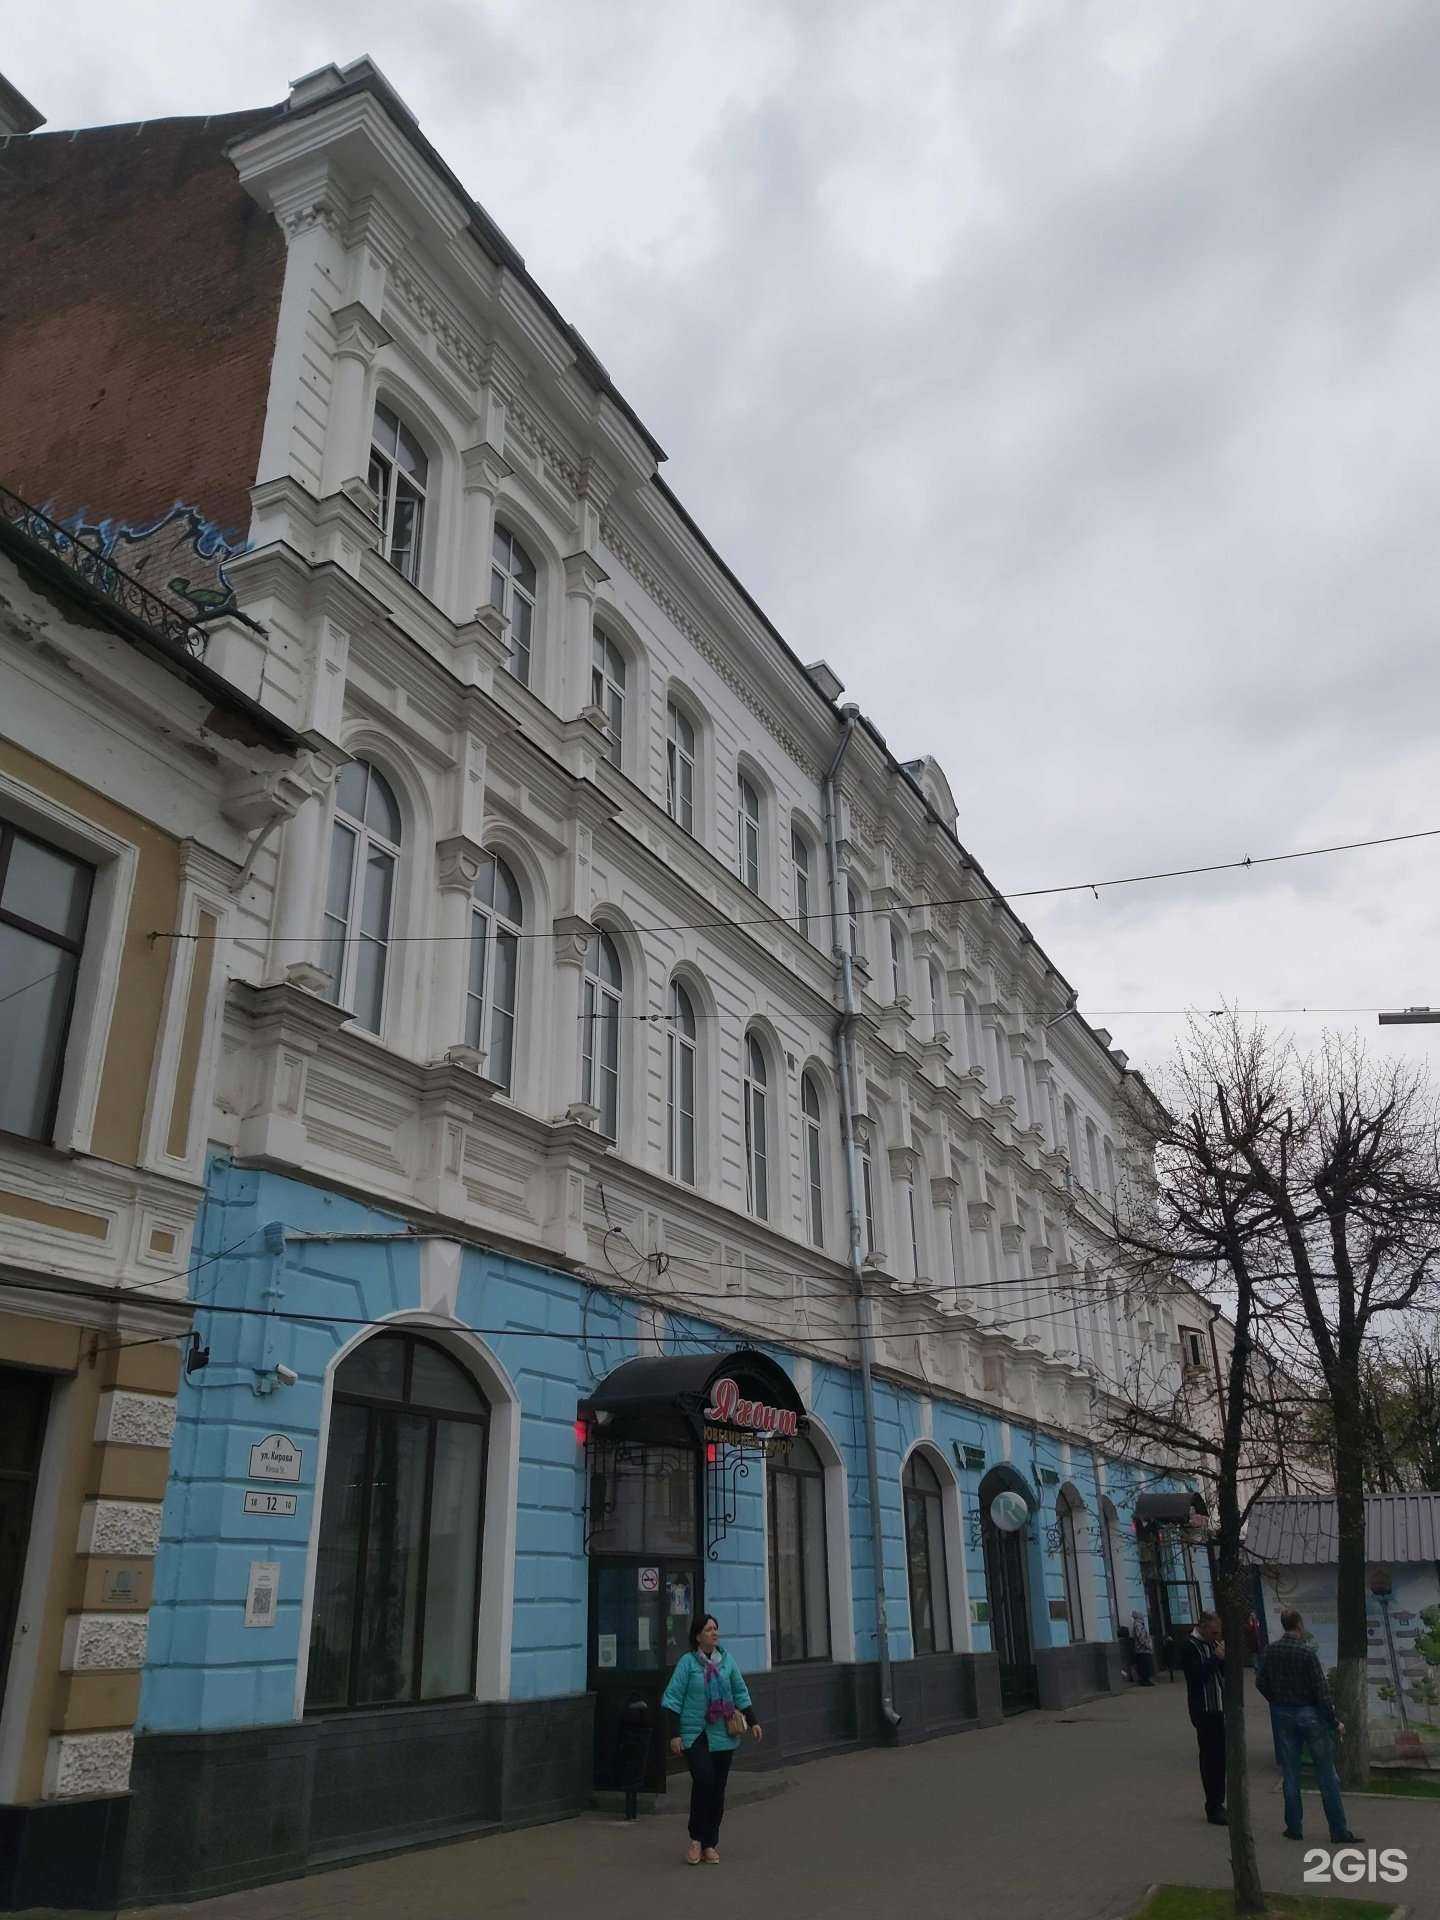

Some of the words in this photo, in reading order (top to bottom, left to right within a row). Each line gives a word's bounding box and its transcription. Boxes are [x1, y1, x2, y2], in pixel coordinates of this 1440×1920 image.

[261, 1452, 270, 1462] ул.
[271, 1450, 293, 1464] Кирова
[267, 1496, 278, 1511] 12
